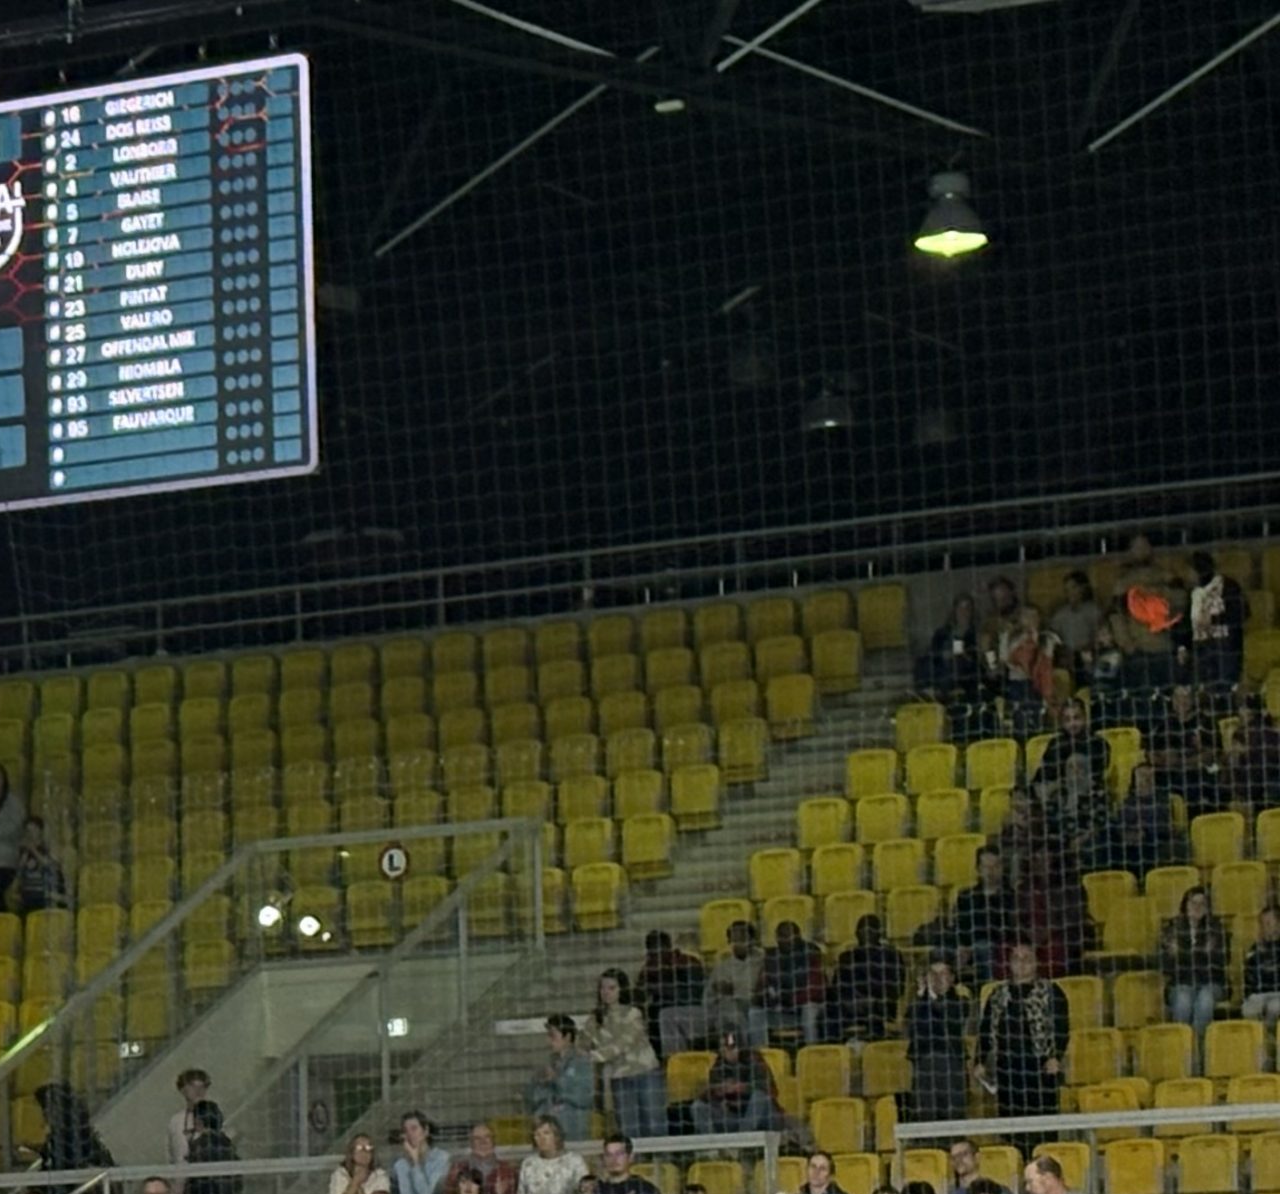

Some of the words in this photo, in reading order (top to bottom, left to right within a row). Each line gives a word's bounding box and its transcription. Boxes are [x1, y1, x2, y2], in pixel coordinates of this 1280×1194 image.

[60, 128, 81, 149] 24
[65, 153, 78, 172] 2
[65, 178, 77, 197] 4
[67, 227, 79, 245] 7
[63, 275, 83, 293] 21
[64, 299, 85, 318] 23
[64, 323, 86, 342] 25
[65, 346, 86, 365] 27
